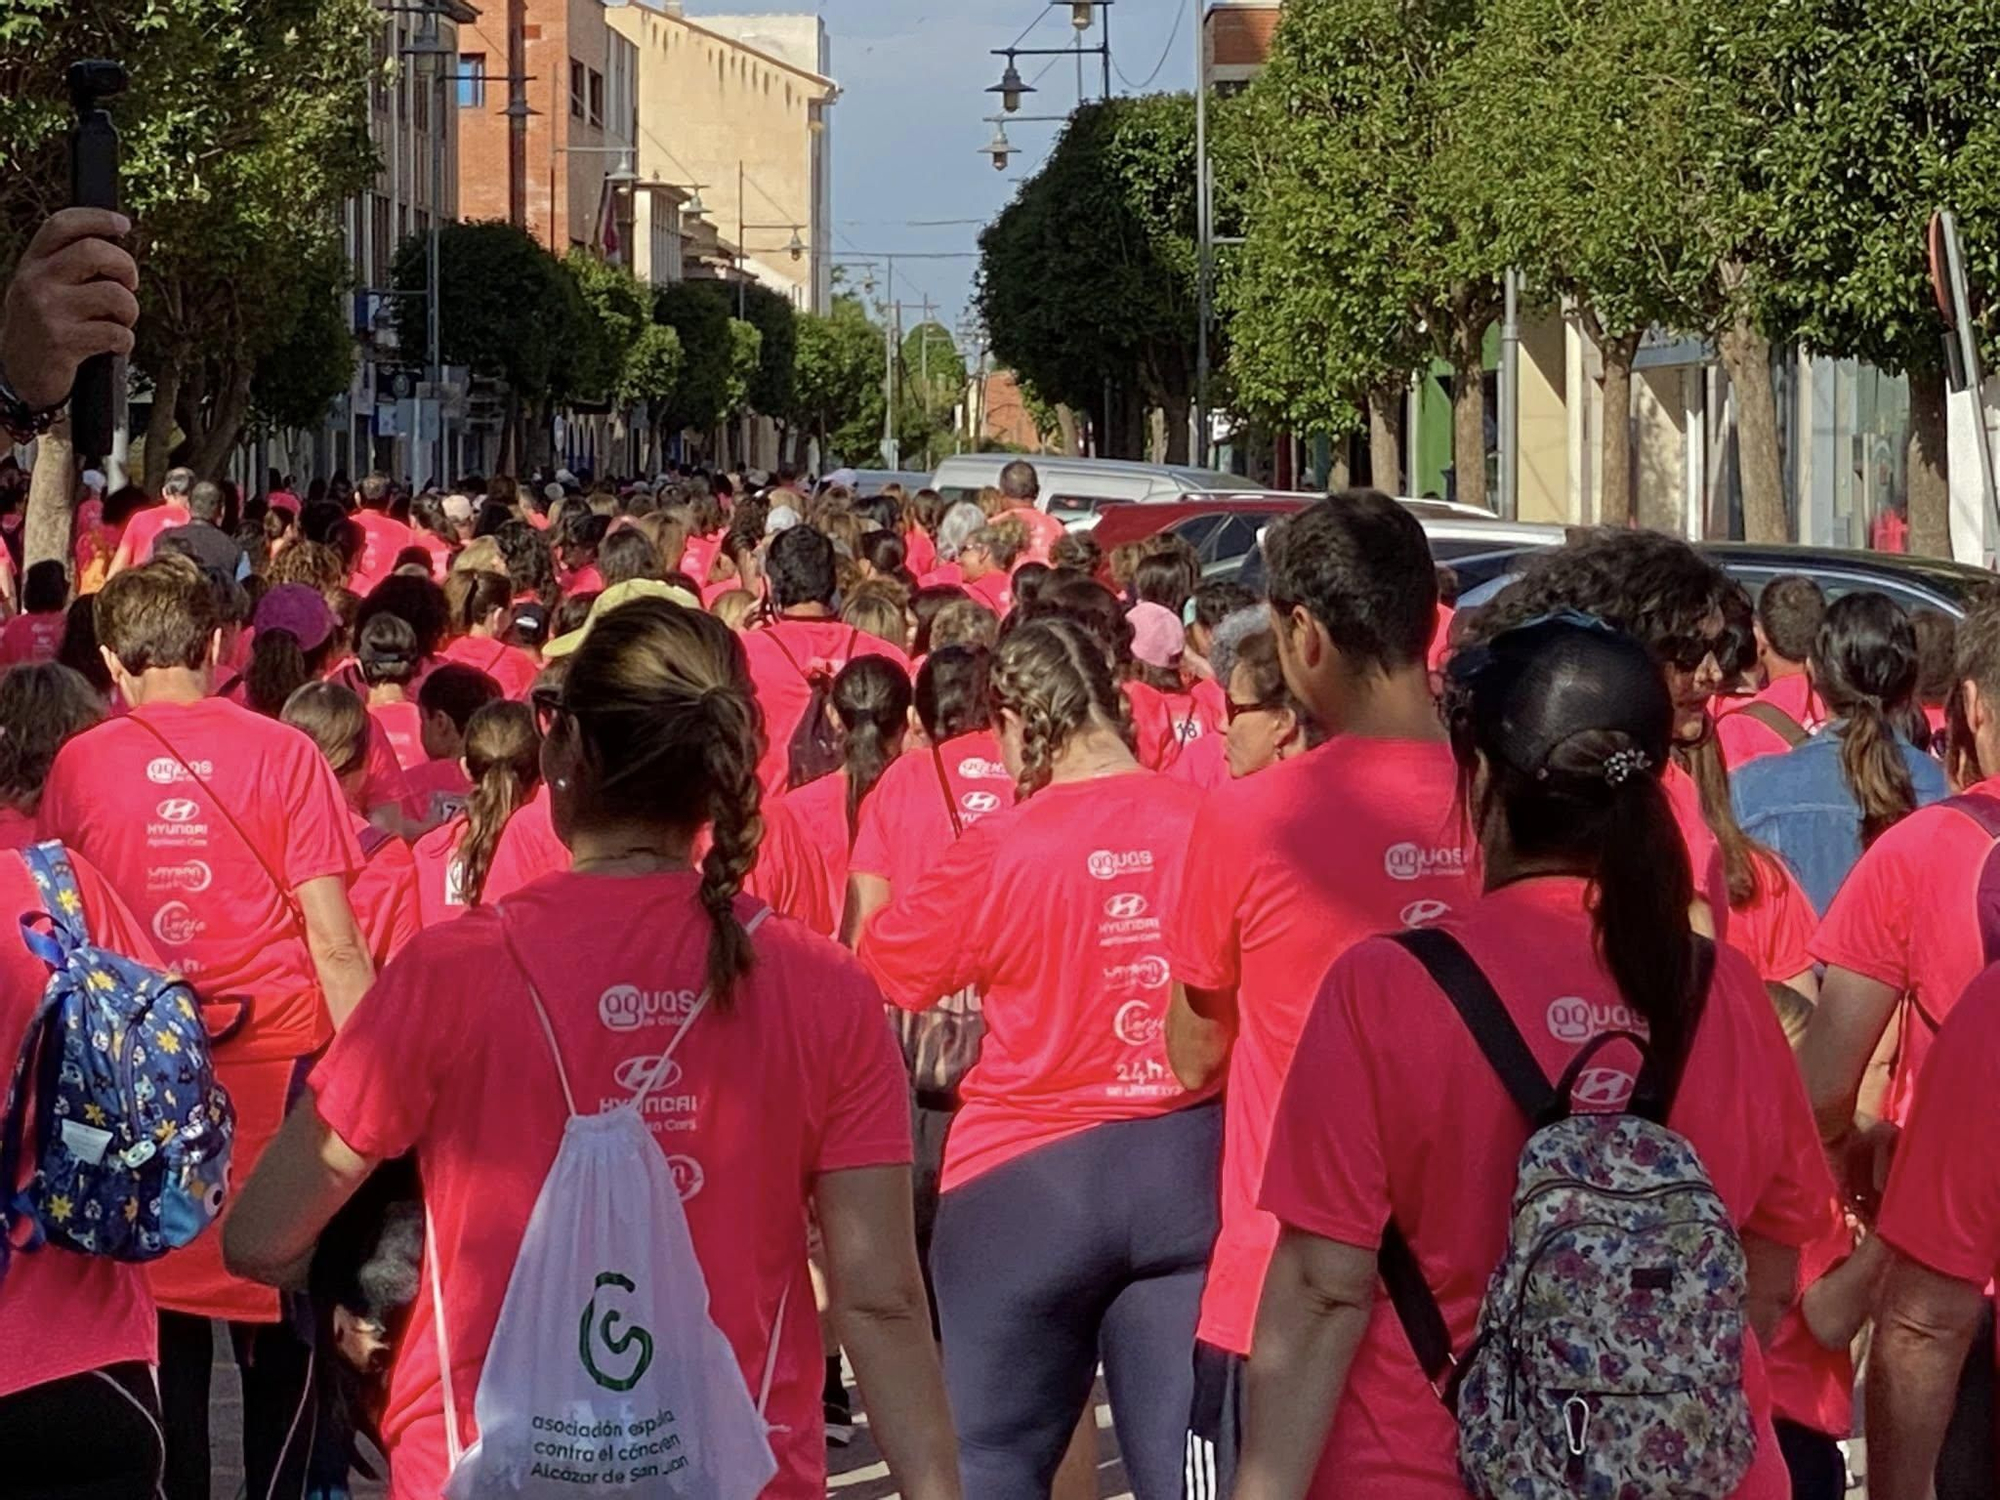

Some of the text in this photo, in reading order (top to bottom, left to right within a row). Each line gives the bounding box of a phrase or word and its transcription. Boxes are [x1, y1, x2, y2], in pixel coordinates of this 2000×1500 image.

[534, 1441, 595, 1462] contra
[598, 1444, 613, 1461] el
[531, 1462, 598, 1484] Alcázar
[602, 1469, 625, 1484] de
